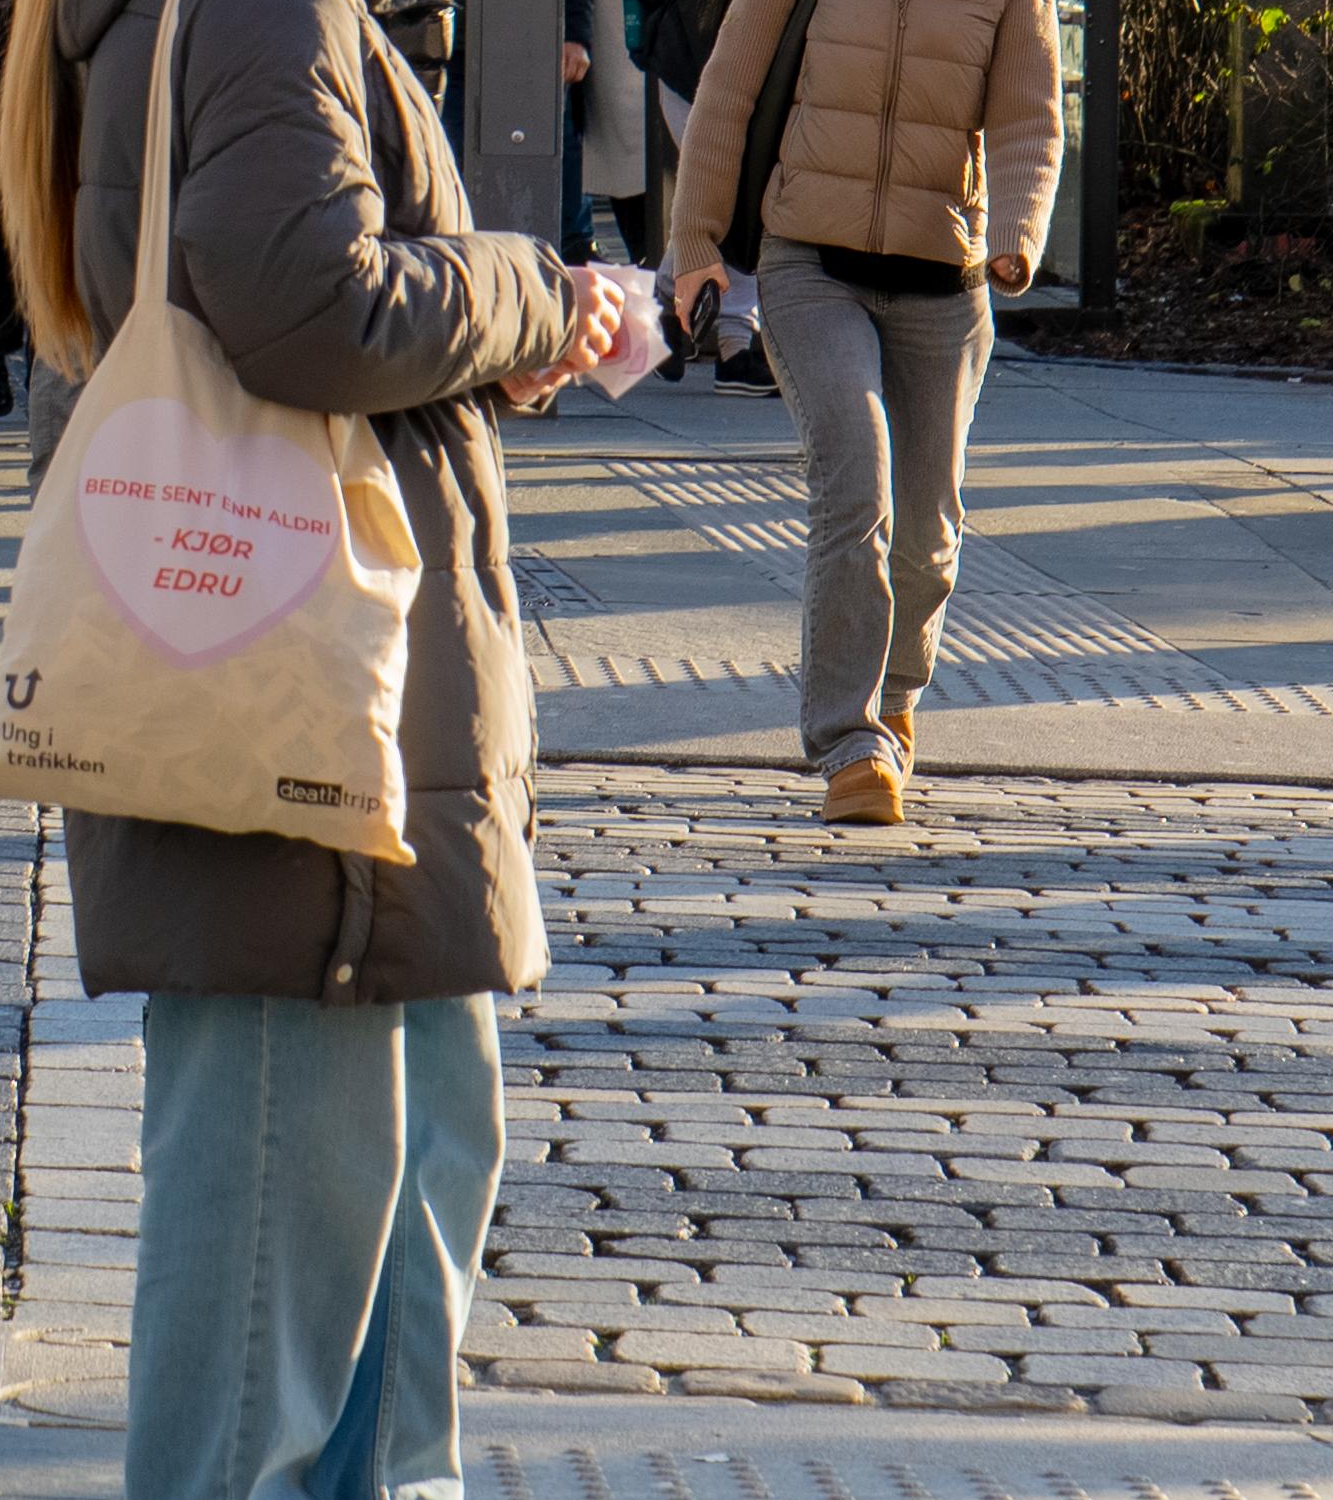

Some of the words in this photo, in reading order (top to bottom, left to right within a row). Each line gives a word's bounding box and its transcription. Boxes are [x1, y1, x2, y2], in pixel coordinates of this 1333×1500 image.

[85, 478, 157, 501] BEDRE
[161, 484, 217, 508] SENT
[222, 494, 263, 520] ENN
[268, 509, 331, 535] ALDRI
[171, 528, 254, 560] KJØR
[153, 567, 243, 597] EDRU
[2, 722, 41, 749] Ung
[47, 727, 53, 746] i
[7, 749, 105, 774] trafikken
